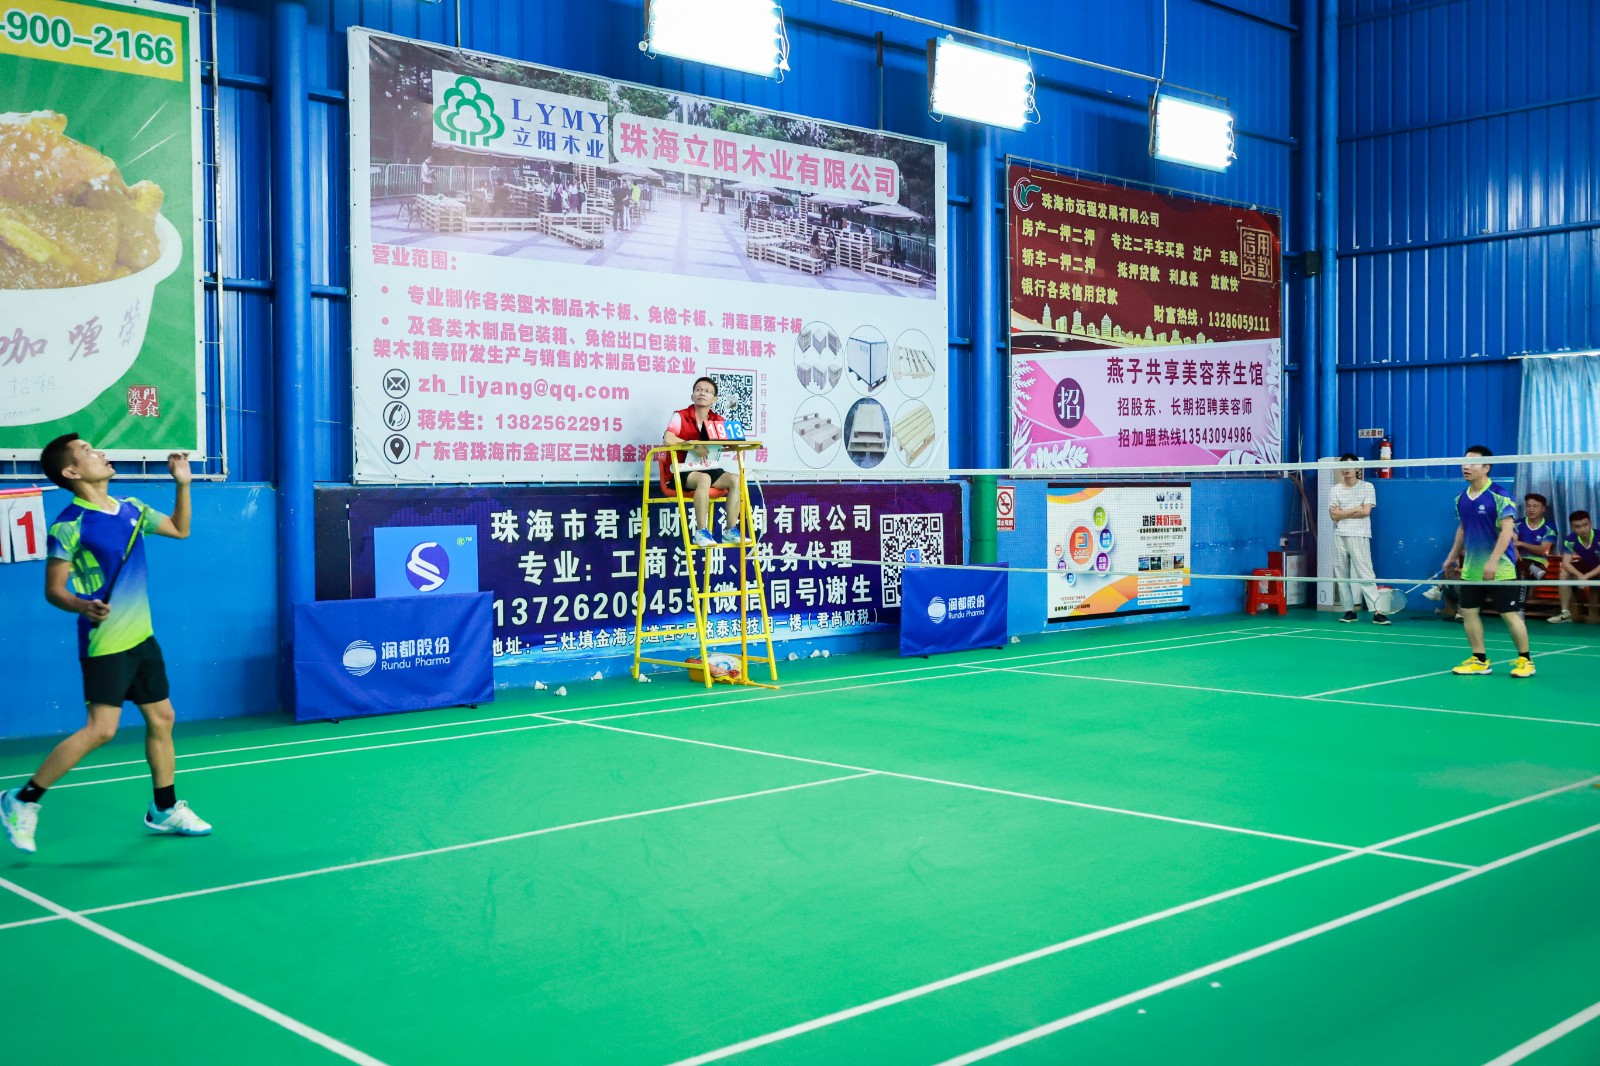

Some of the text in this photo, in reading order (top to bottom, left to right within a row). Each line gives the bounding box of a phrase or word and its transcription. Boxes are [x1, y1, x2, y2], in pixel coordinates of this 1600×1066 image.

[0, 11, 174, 65] 900-2166
[511, 98, 608, 134] LYMY
[512, 126, 605, 159] 立阳木业
[620, 122, 895, 197] 珠海立阳木业有限公司
[1041, 192, 1160, 228] 珠海市远程发展有限公司
[1021, 218, 1238, 267] 房产一押二押 专注二手车买卖 过户 车险
[1243, 231, 1269, 256] 信用
[372, 244, 457, 271] 营业范围：
[1021, 248, 1239, 292] 轿车一押二押 抵押贷款 利息低 放款快
[1021, 277, 1118, 306] 银行各类信用贷款
[373, 337, 696, 375] 架木箱等研发生产与销售的木制品包装企业
[1107, 356, 1263, 386] 燕子共享美容养生馆
[418, 374, 630, 402] zh_liyang@qq.com
[129, 402, 159, 417] 美食
[1057, 386, 1082, 421] 招
[1117, 396, 1252, 417] 招股东、长期招聘美容师
[417, 408, 622, 432] 蒋先生：13825622915
[727, 423, 744, 438] 13
[1118, 426, 1252, 448] 招加盟热线13543094986
[17, 511, 36, 554] 1
[948, 594, 985, 612] 润都股份
[948, 609, 985, 620] Rundu Pharma
[381, 636, 450, 660] 润都股份
[381, 655, 450, 670] Rundu Pharma
